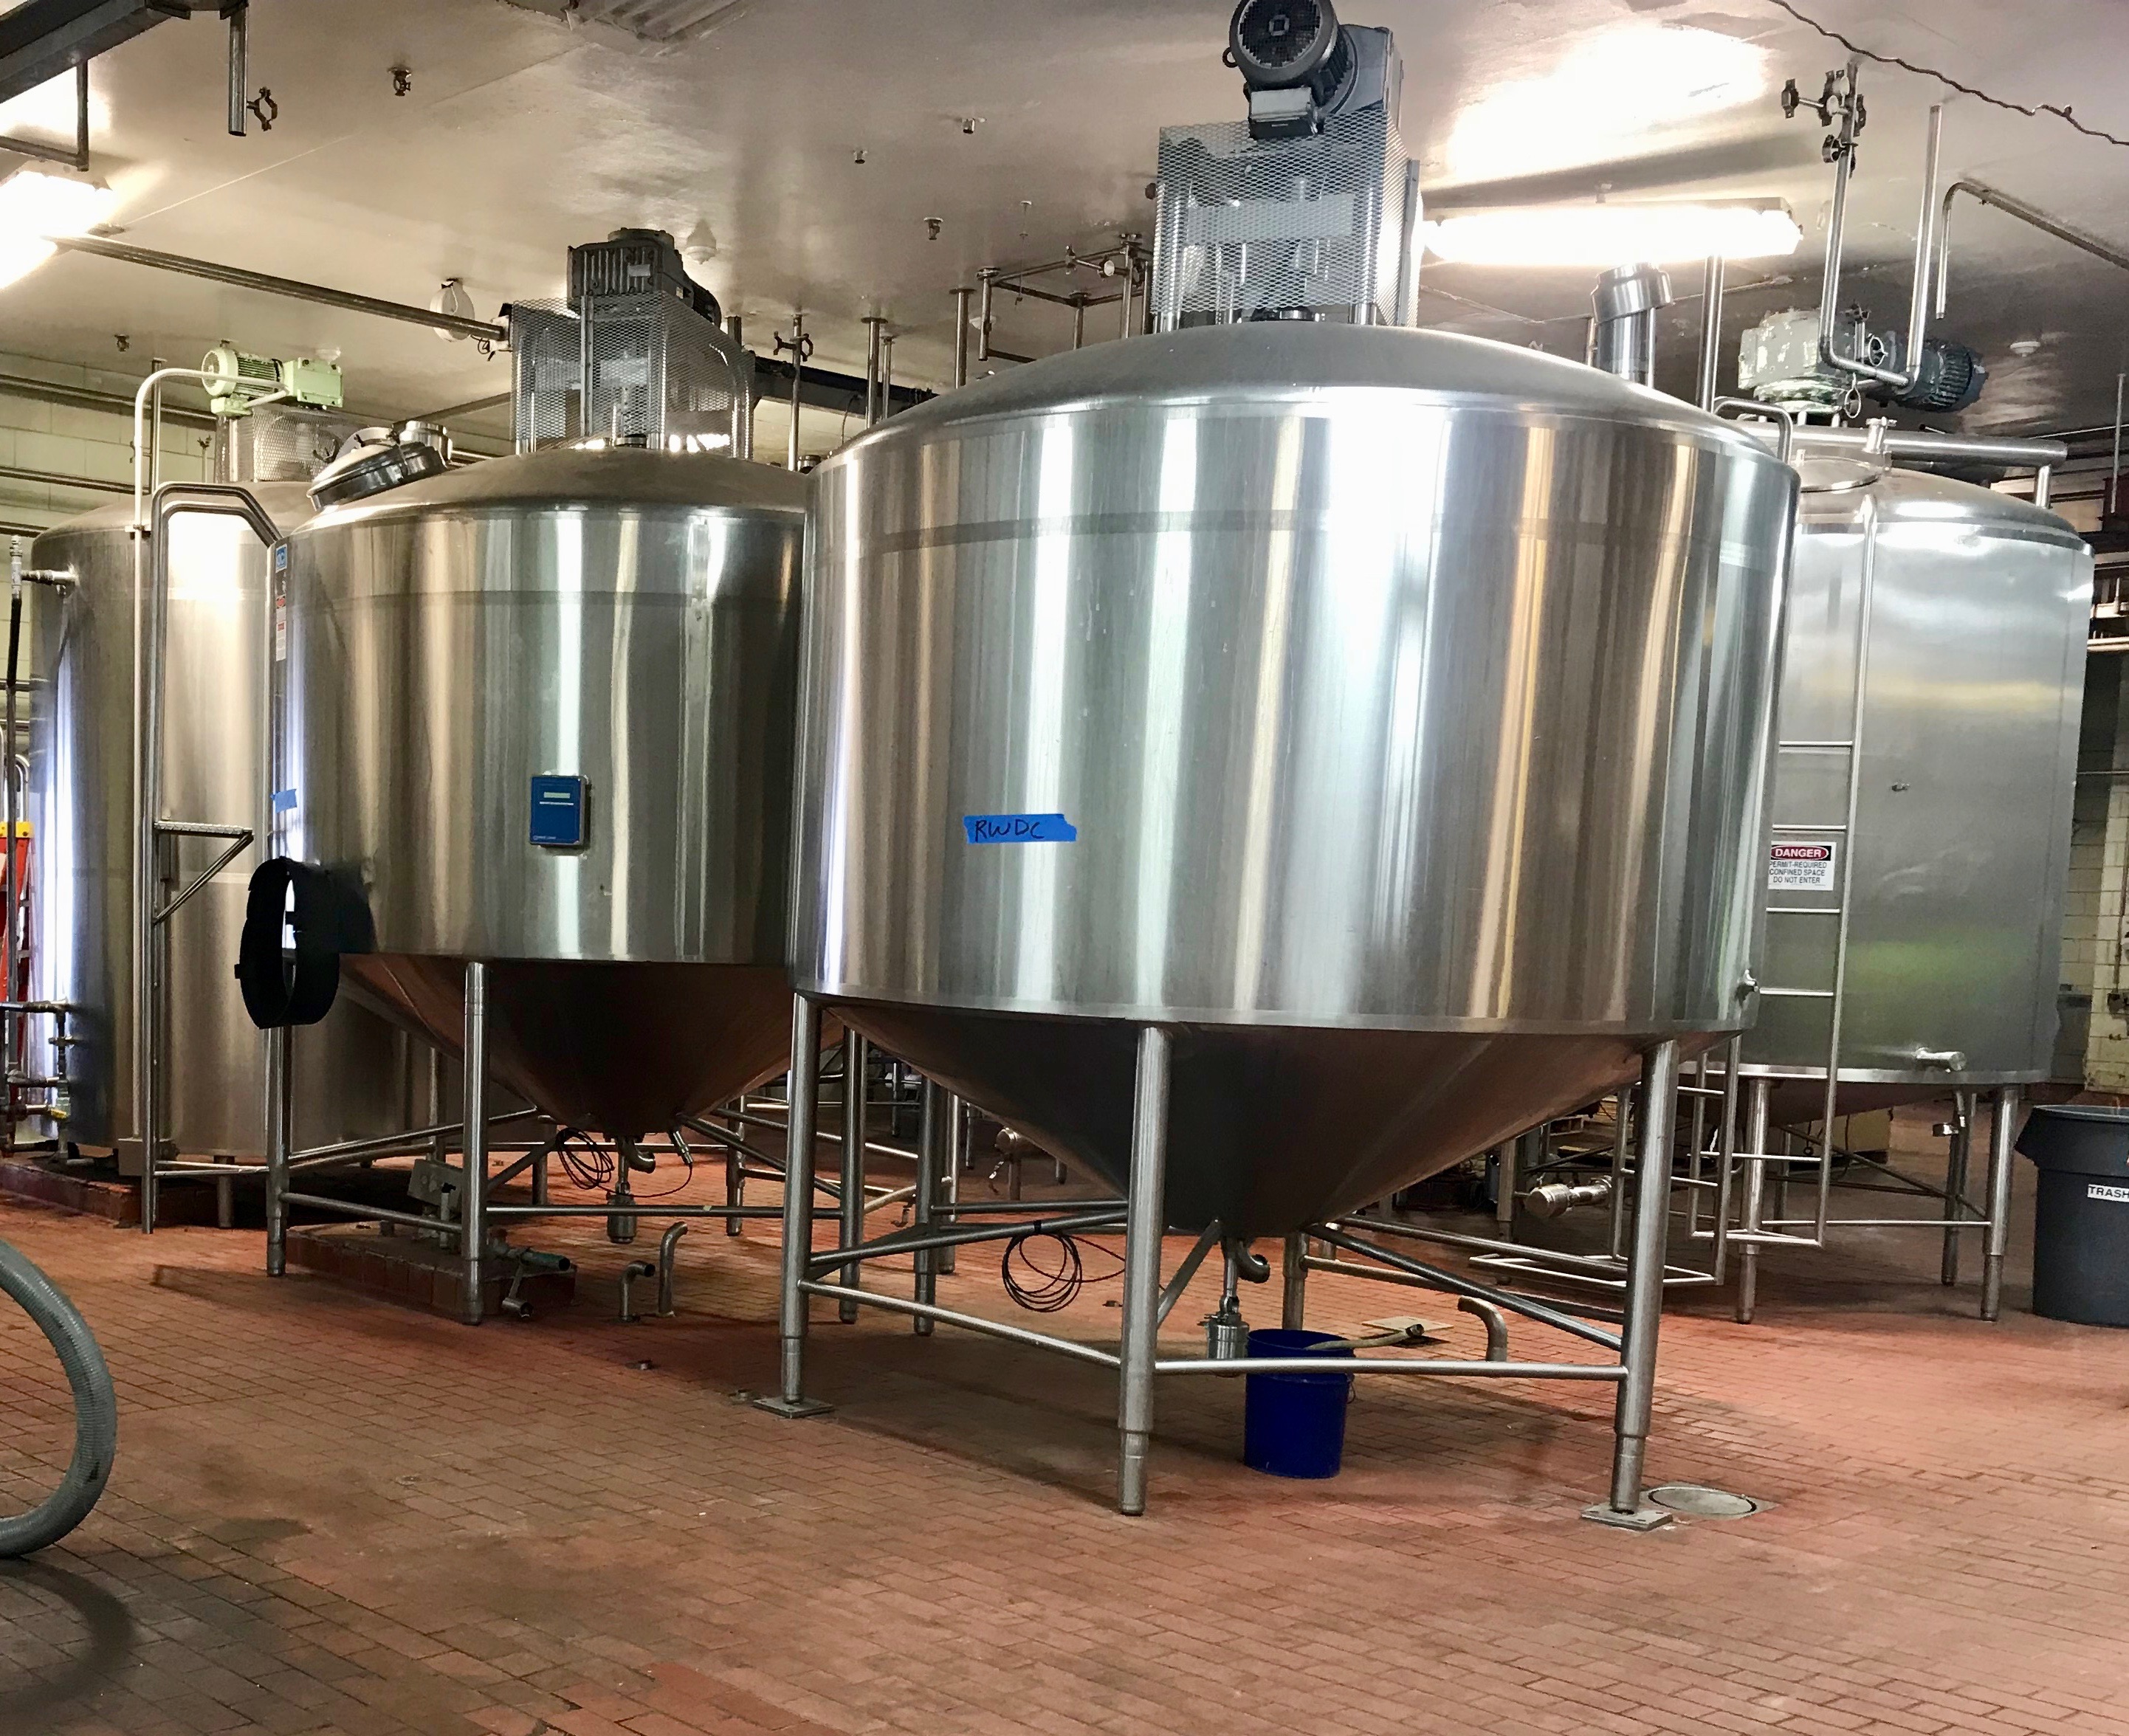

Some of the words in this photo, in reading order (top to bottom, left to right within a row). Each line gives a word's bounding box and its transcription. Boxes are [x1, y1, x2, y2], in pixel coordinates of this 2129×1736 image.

[975, 819, 1045, 843] RWDC
[1775, 848, 1822, 858] DANGER
[2088, 1186, 2129, 1199] TRASH
